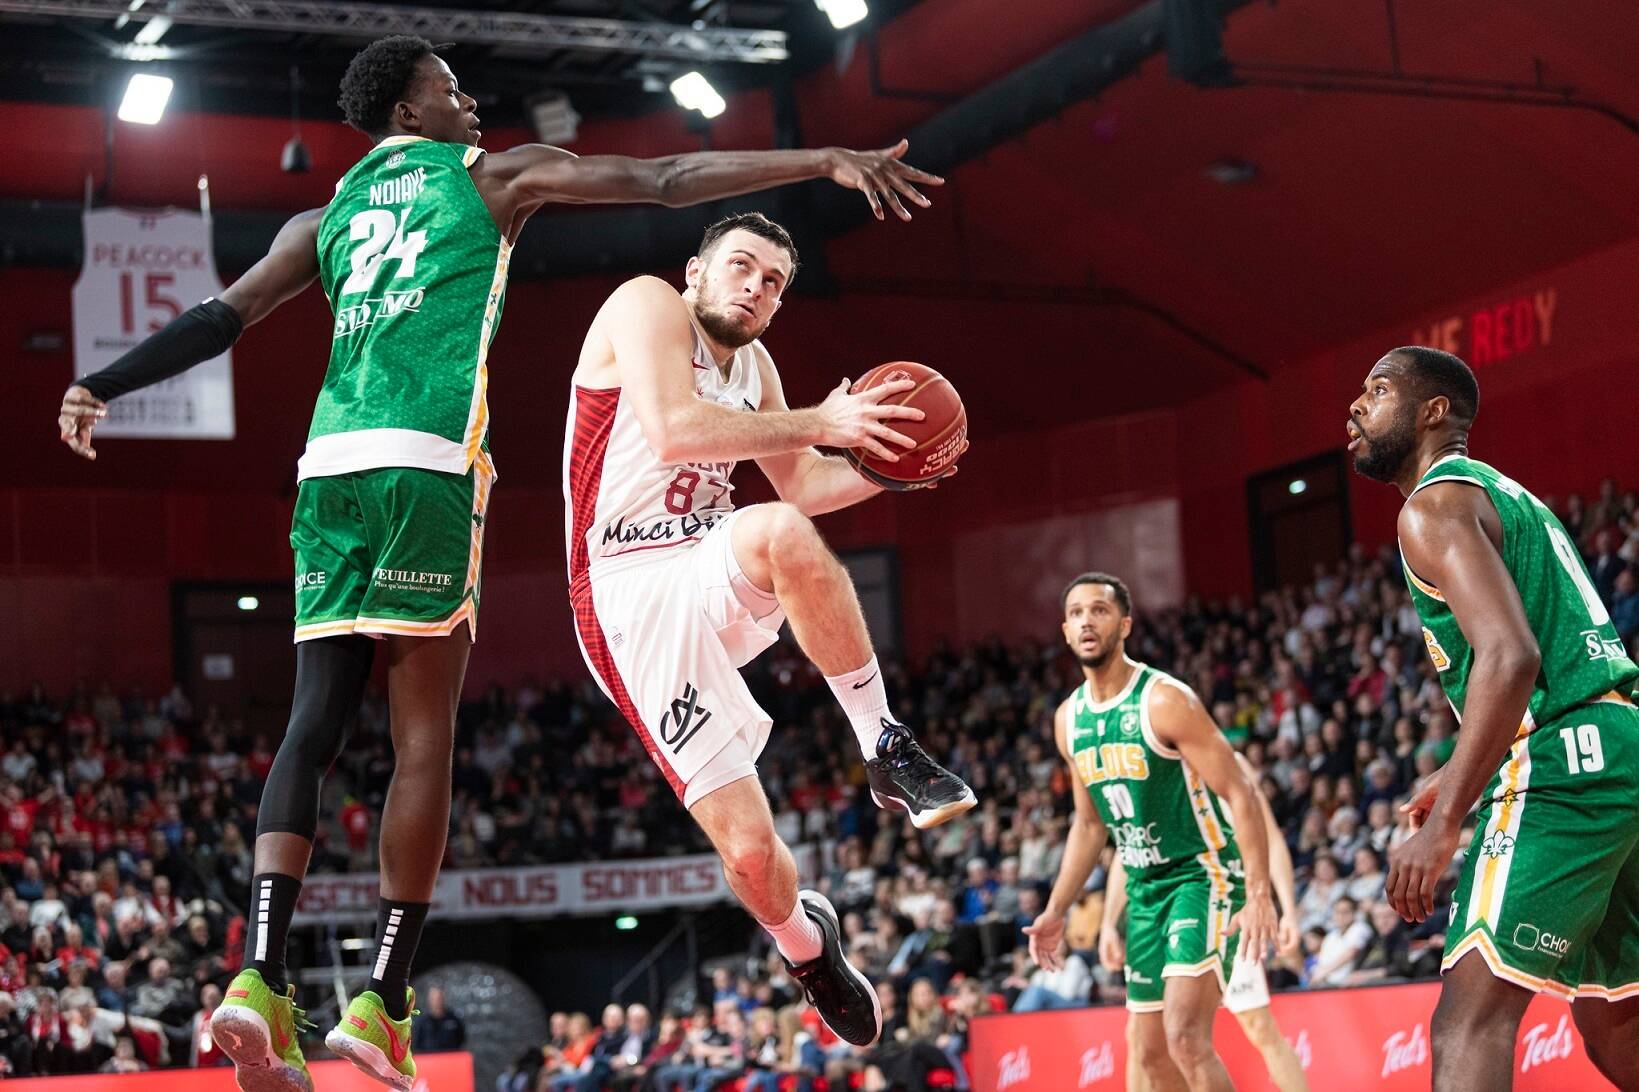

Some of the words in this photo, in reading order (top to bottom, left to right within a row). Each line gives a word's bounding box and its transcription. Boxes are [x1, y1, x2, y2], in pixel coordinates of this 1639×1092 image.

[93, 243, 206, 269] PEACOCK
[343, 207, 429, 296] 24
[119, 271, 183, 336] 15
[1472, 288, 1557, 366] REDY
[664, 469, 728, 515] 87
[1559, 724, 1605, 775] 19
[463, 872, 557, 905] NOUS
[582, 863, 716, 899] SOMMES
[1381, 1023, 1427, 1078] Teds
[1521, 1014, 1573, 1073] Teds
